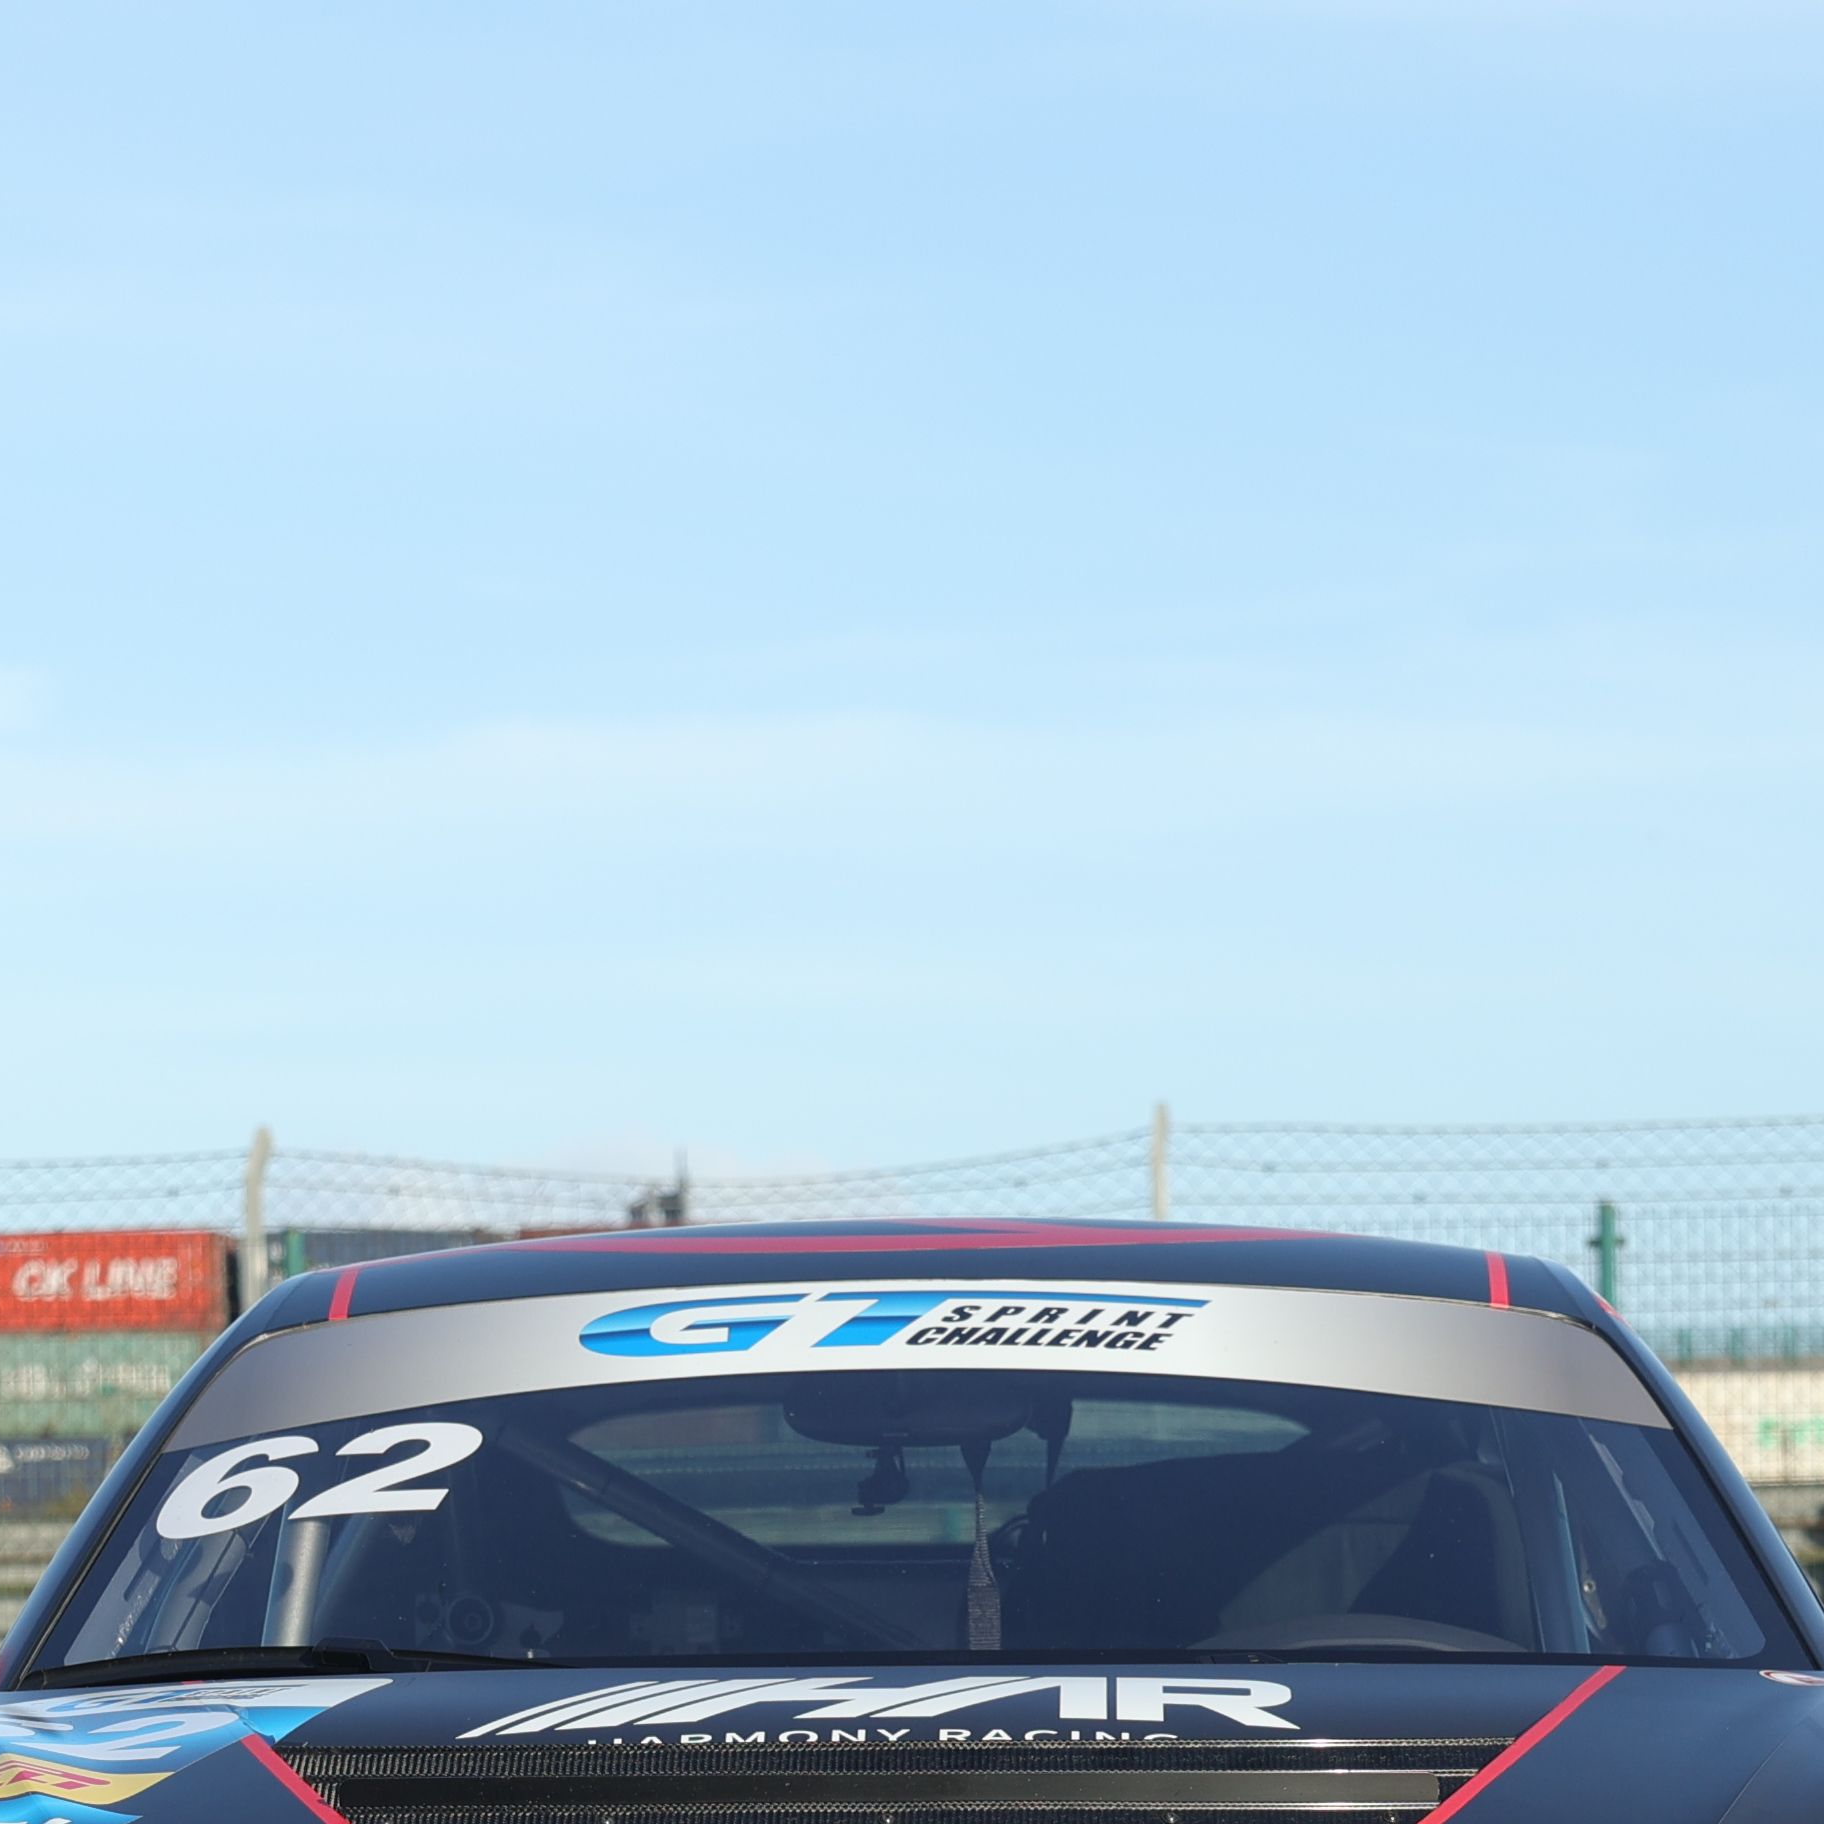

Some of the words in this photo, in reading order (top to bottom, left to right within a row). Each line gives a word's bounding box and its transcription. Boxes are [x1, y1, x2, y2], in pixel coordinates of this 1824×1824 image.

[80, 1256, 179, 1302] LINE
[578, 1290, 951, 1357] GT
[905, 1327, 1173, 1351] CHALLENGE
[942, 1305, 1194, 1328] SPRINT
[156, 1422, 483, 1540] 62
